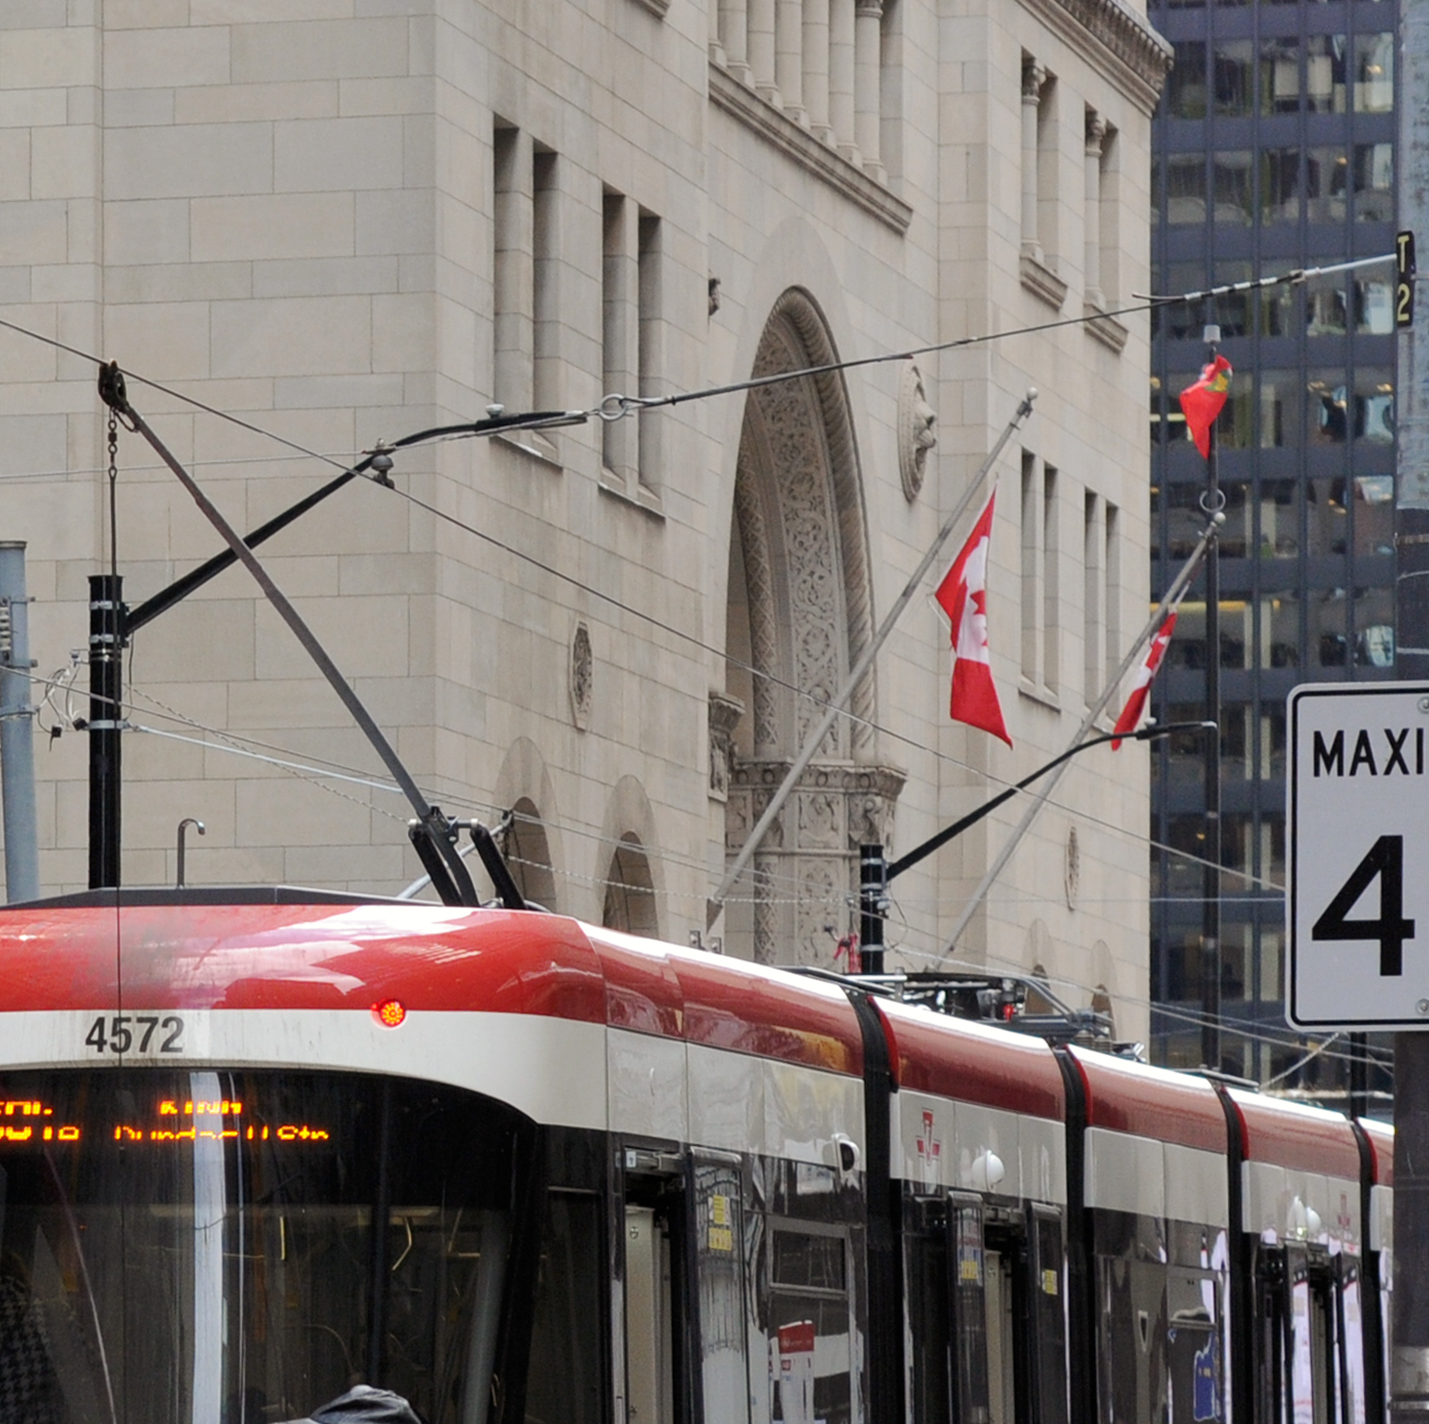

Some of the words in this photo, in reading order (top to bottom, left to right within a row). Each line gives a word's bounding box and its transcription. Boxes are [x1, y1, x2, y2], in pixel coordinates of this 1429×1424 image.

[1313, 727, 1424, 777] MAXI
[1312, 834, 1416, 977] 4
[85, 1016, 184, 1054] 4572
